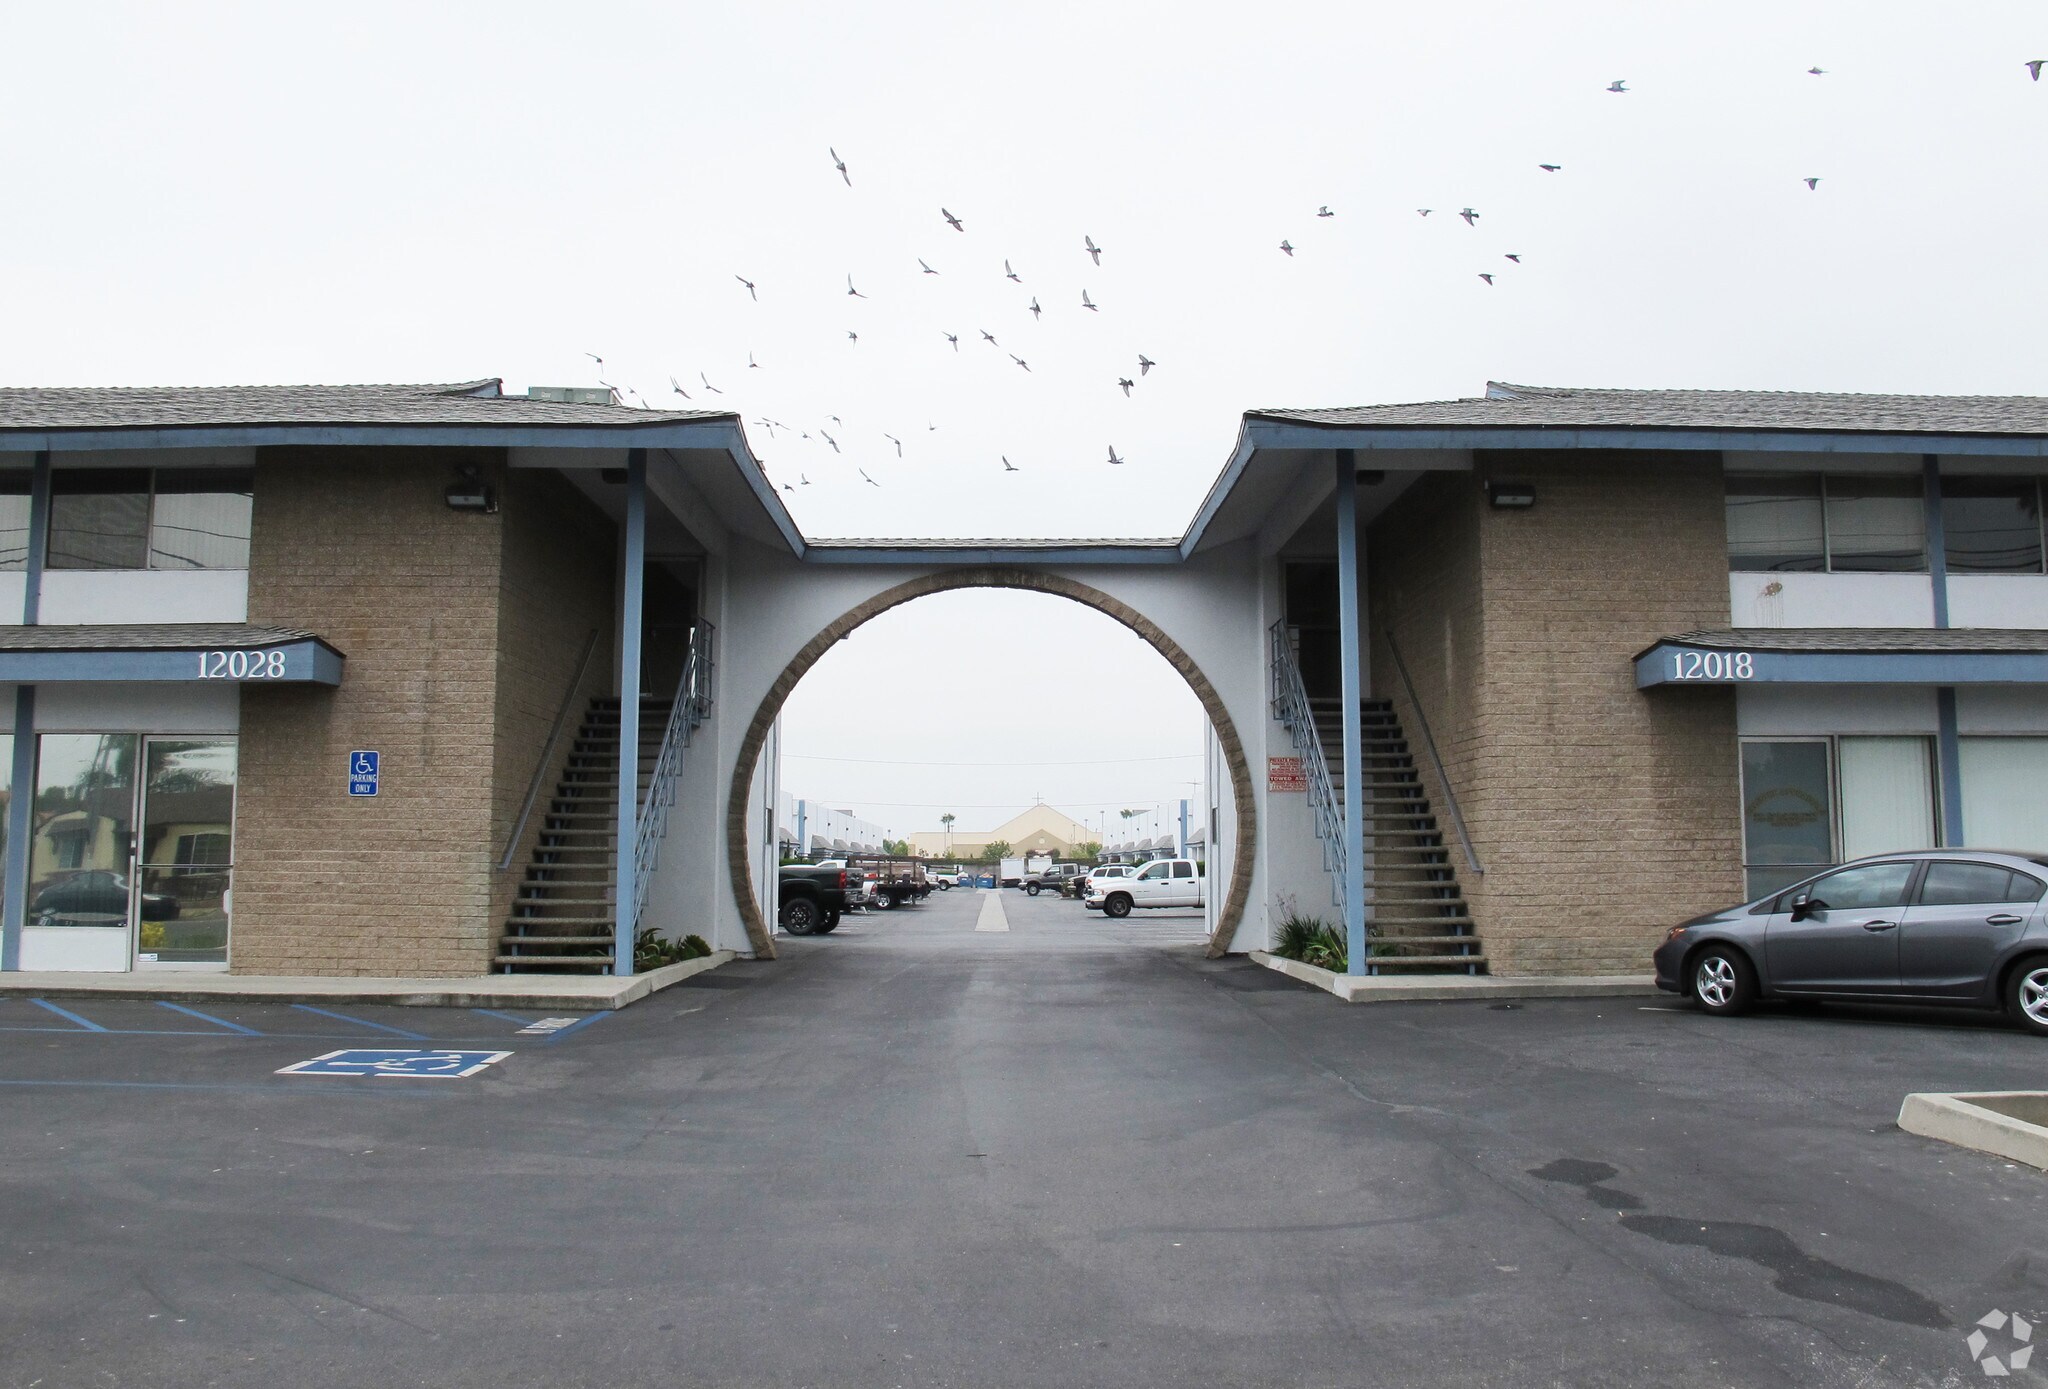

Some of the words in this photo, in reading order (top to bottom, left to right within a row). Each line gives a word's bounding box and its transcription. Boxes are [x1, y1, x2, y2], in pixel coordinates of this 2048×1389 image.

[198, 651, 286, 678] 12028
[1674, 652, 1754, 680] 12018
[351, 774, 377, 782] PARKING
[355, 784, 371, 793] ONLY
